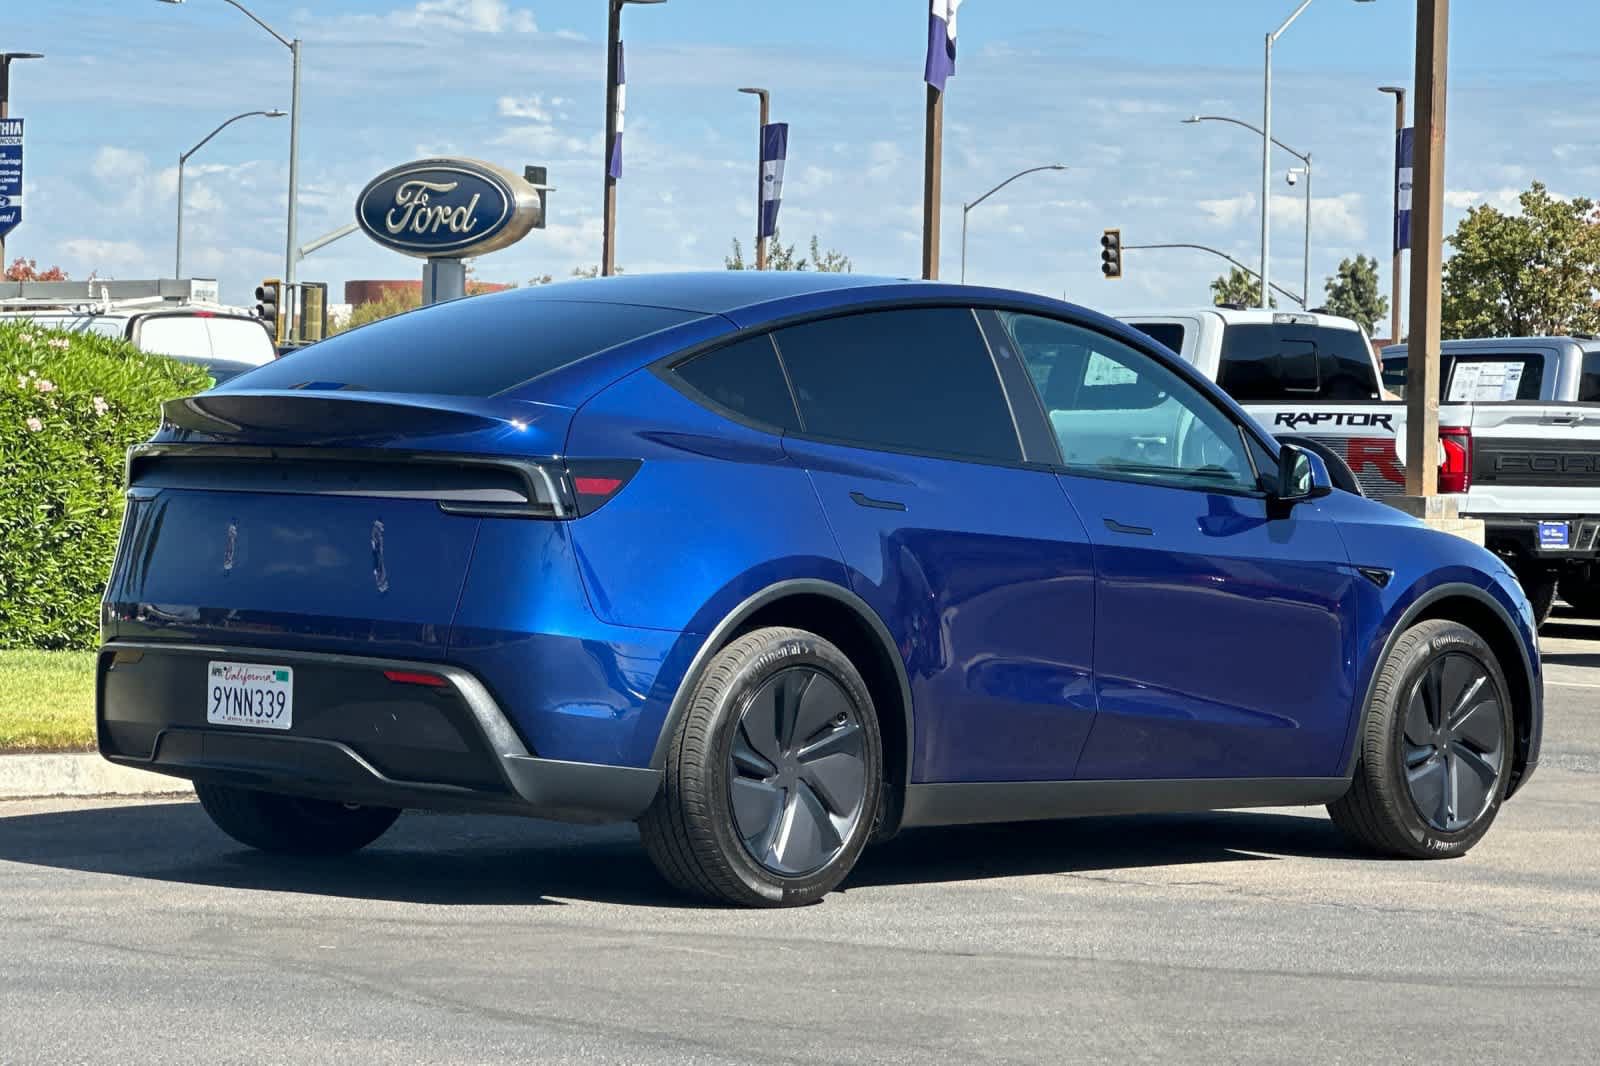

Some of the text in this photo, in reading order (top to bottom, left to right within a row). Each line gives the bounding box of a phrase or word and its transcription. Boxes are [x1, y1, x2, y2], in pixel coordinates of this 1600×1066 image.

[0, 122, 21, 135] HIA
[385, 180, 481, 234] Ford
[1274, 412, 1395, 433] RAPTOR
[1495, 455, 1600, 472] FOR
[224, 667, 271, 685] California
[212, 687, 286, 718] 9YNN339
